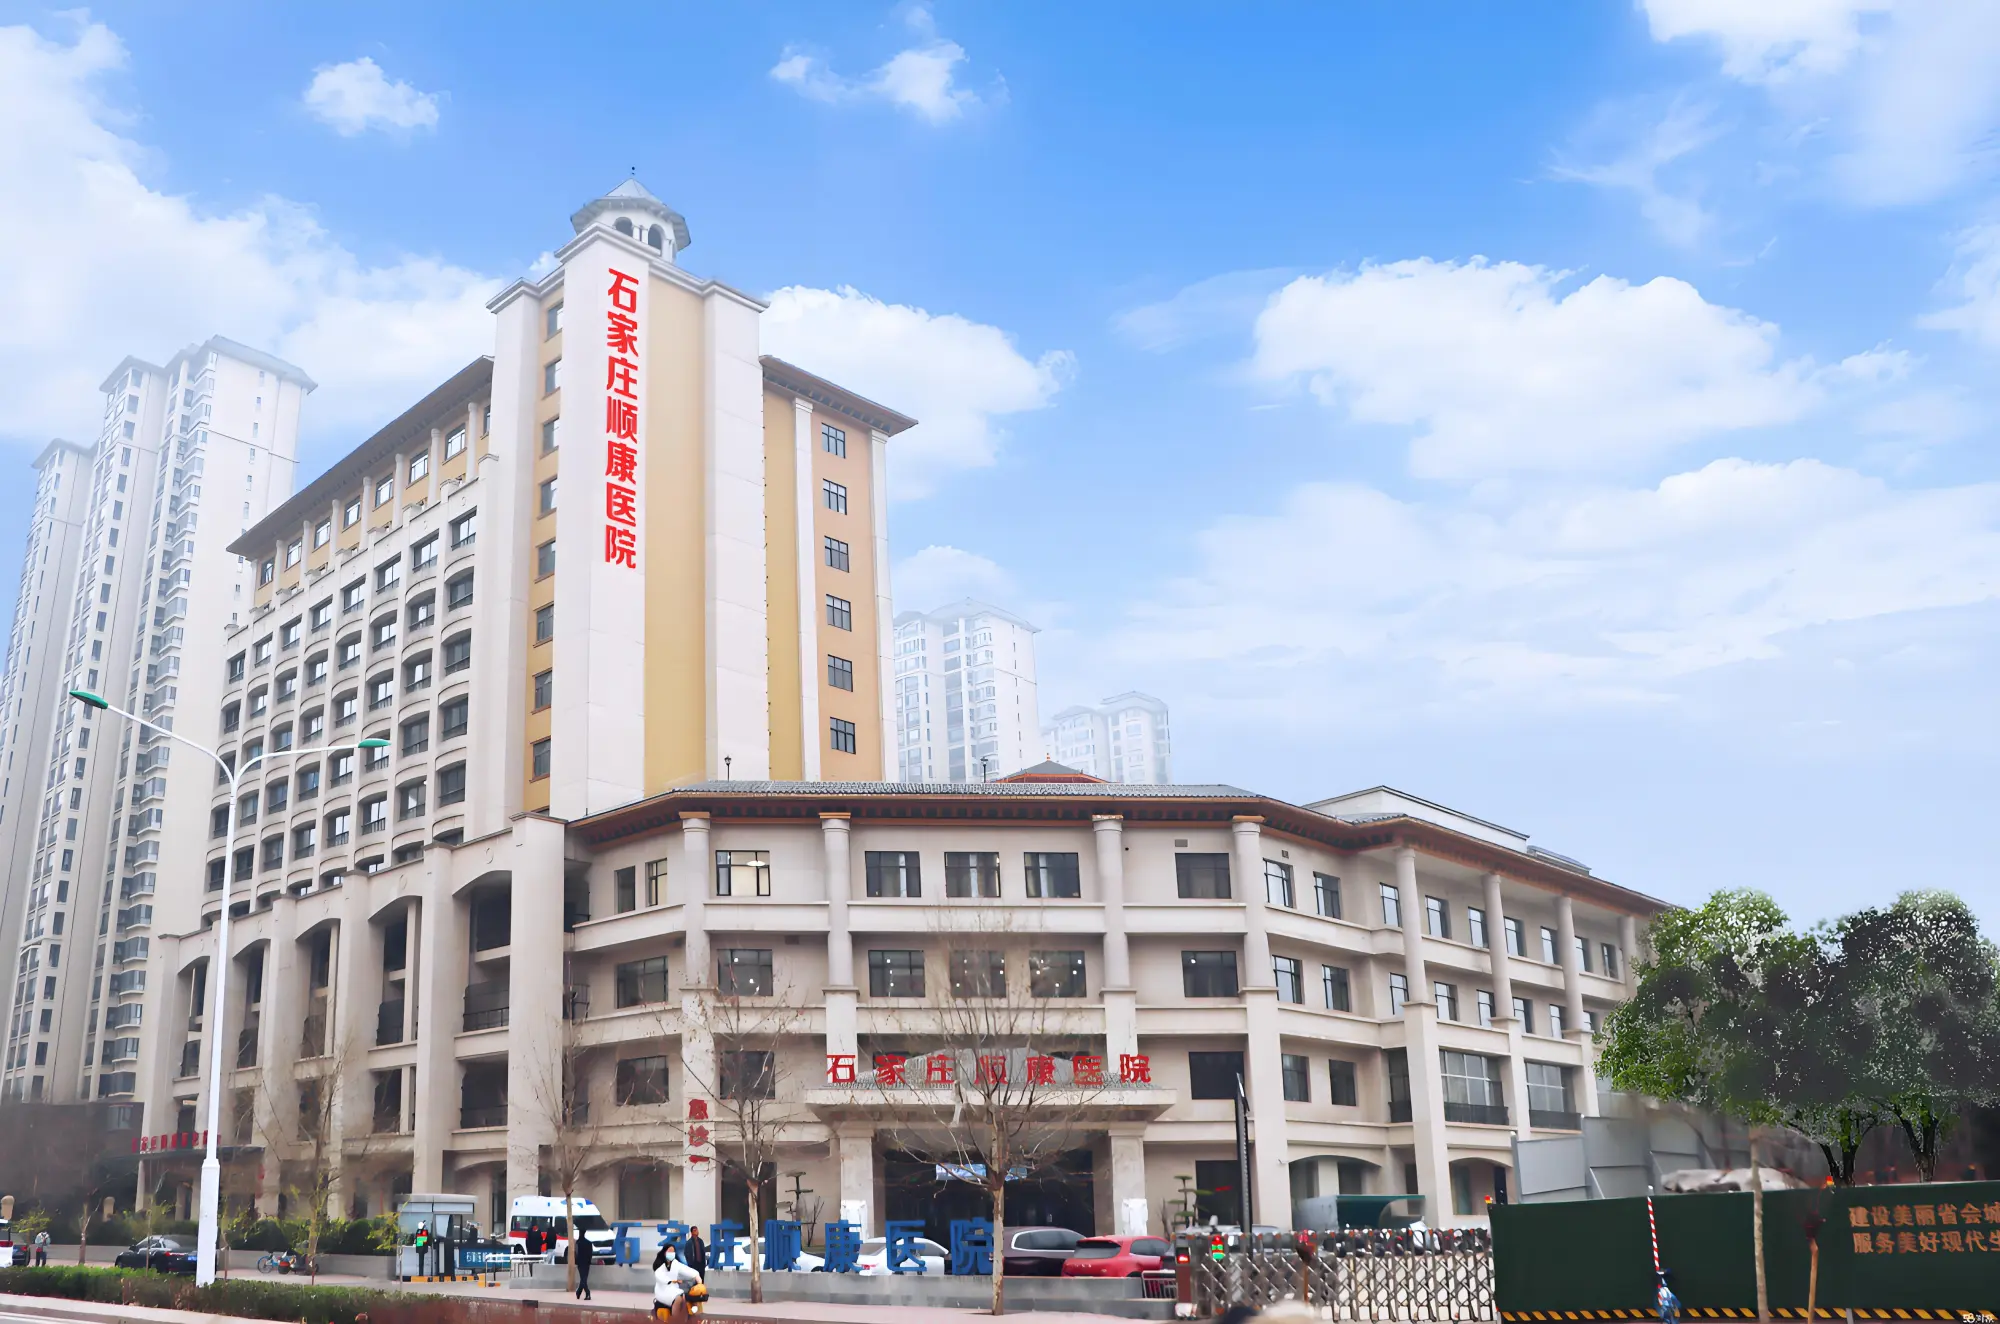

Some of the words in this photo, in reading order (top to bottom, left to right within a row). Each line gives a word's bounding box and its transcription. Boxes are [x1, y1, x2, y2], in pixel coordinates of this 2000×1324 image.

[604, 267, 639, 569] 石家庄顺康医院
[826, 1053, 1151, 1086] 石家庄顺康医院
